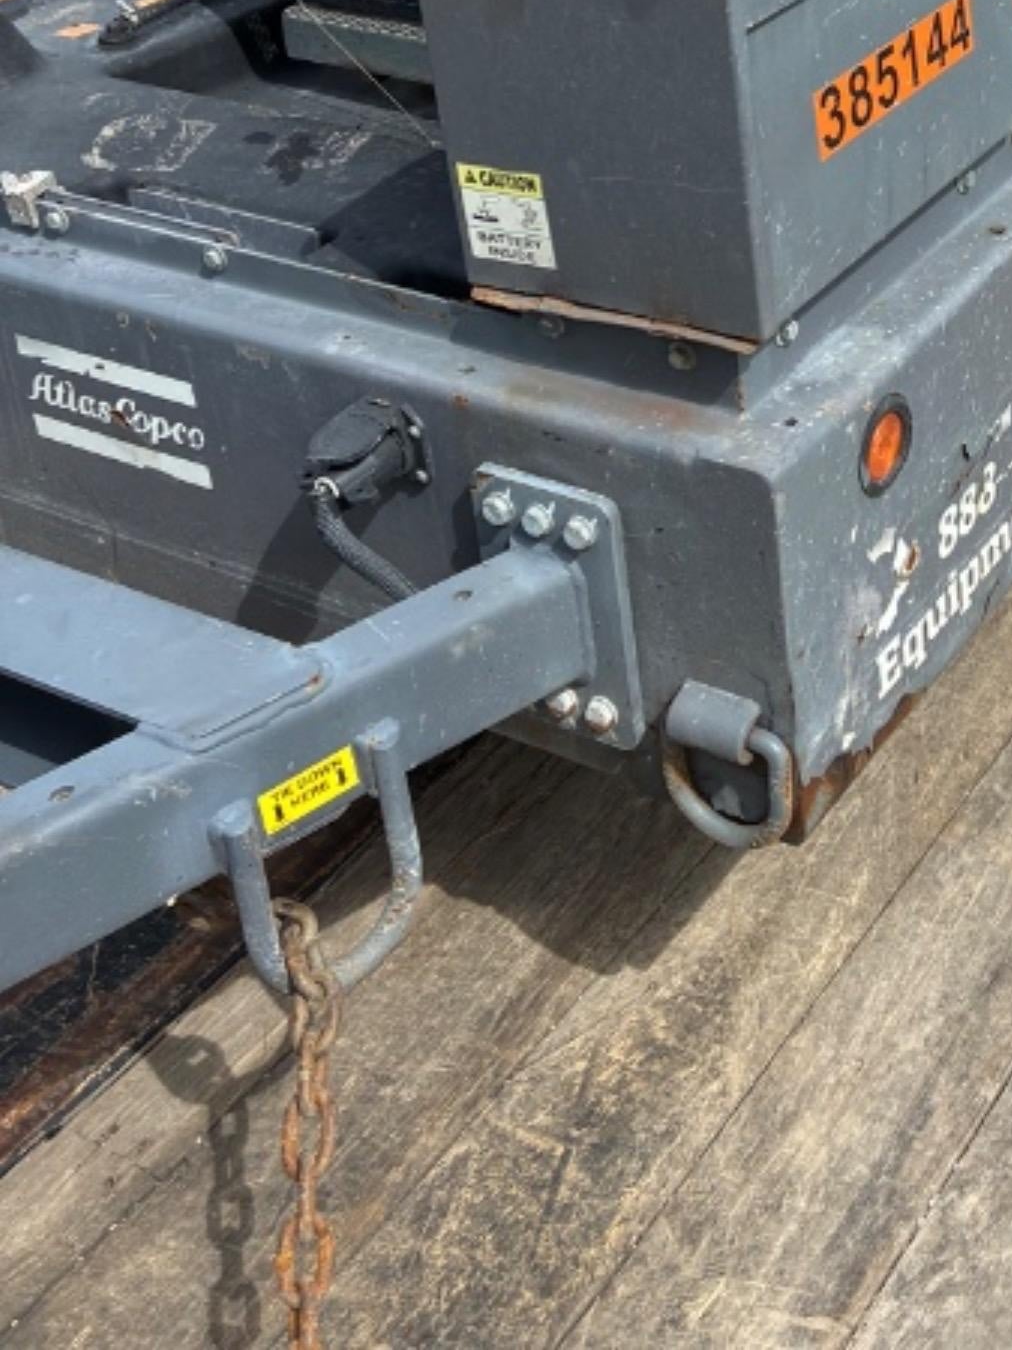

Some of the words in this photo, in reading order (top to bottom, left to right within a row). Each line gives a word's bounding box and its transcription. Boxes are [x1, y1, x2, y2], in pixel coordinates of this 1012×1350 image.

[479, 170, 538, 193] CAUTION
[477, 231, 542, 250] BATTERY
[28, 372, 113, 425] Atlas
[114, 397, 206, 450] Copco
[296, 756, 344, 791] DOWN
[289, 779, 331, 807] HERE
